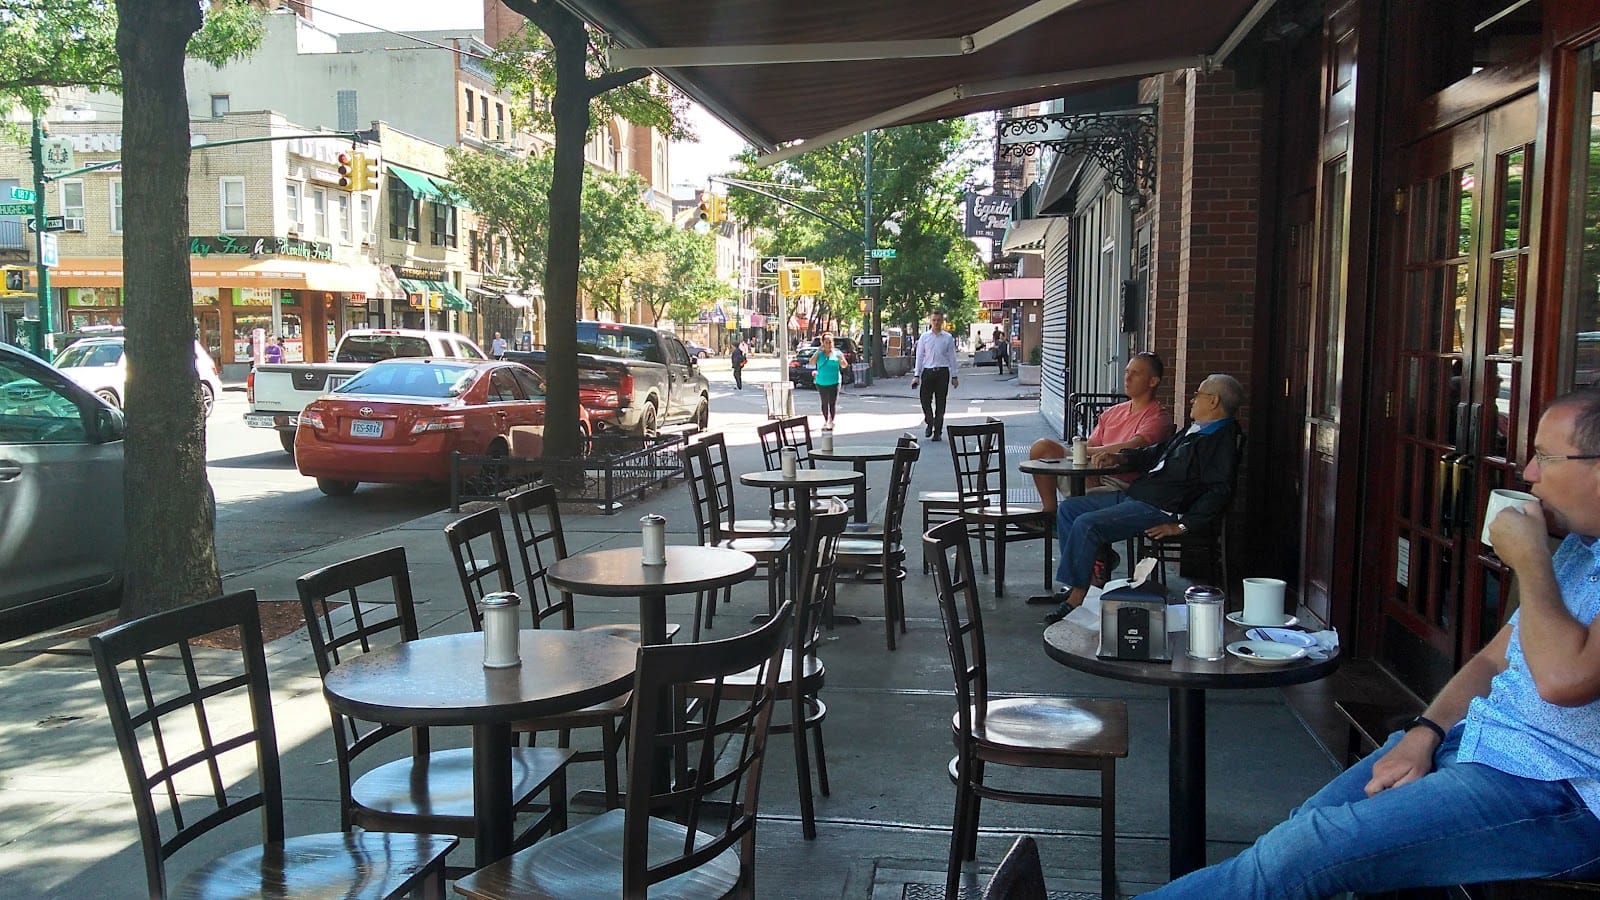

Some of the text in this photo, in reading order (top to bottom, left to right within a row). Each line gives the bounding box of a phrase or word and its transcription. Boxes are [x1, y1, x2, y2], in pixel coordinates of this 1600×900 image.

[0, 205, 27, 214] HUGHES
[48, 219, 60, 227] WAY
[767, 259, 778, 269] ON
[981, 301, 1000, 309] ATM
